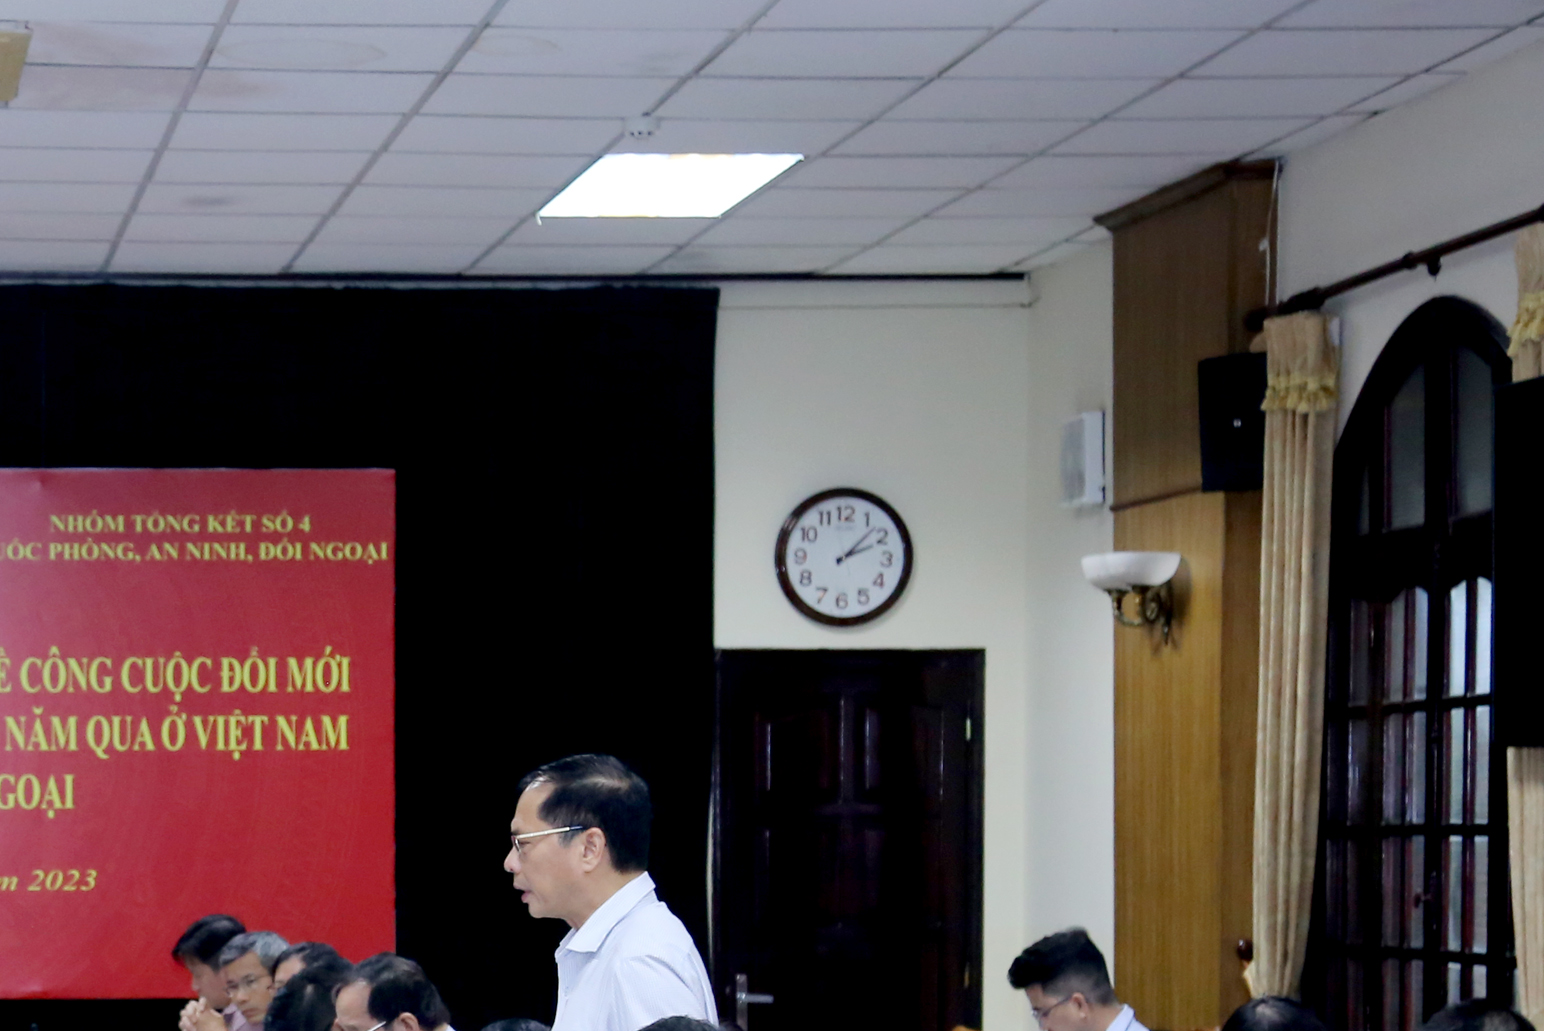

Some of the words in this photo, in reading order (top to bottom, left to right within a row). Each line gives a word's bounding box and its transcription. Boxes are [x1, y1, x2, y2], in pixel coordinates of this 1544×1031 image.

[50, 510, 125, 533] NHÓM
[299, 515, 312, 533] 4
[819, 510, 832, 526] 11
[836, 505, 855, 523] 12
[864, 511, 870, 527] 1
[800, 526, 818, 543] 10
[876, 528, 888, 545] 2
[49, 538, 142, 562] PHÒNG,
[146, 542, 180, 561] AN
[185, 541, 254, 562] NINH,
[309, 542, 388, 564] NGOẠI
[794, 549, 807, 565] 9
[880, 551, 893, 568] 3
[799, 570, 812, 587] 8
[873, 573, 885, 589] 4
[816, 587, 828, 604] 7
[835, 593, 849, 610] 6
[857, 588, 870, 606] 5
[19, 645, 113, 694] CÔNG
[120, 651, 214, 702] CUỘC
[220, 646, 278, 693] ĐỔI
[286, 645, 351, 693] MỚI
[5, 706, 78, 752] NĂM
[86, 715, 156, 760] QUA
[160, 705, 188, 752] Ở
[192, 709, 270, 761] VIỆT
[275, 714, 350, 751] NAM
[27, 869, 98, 892] 2023
